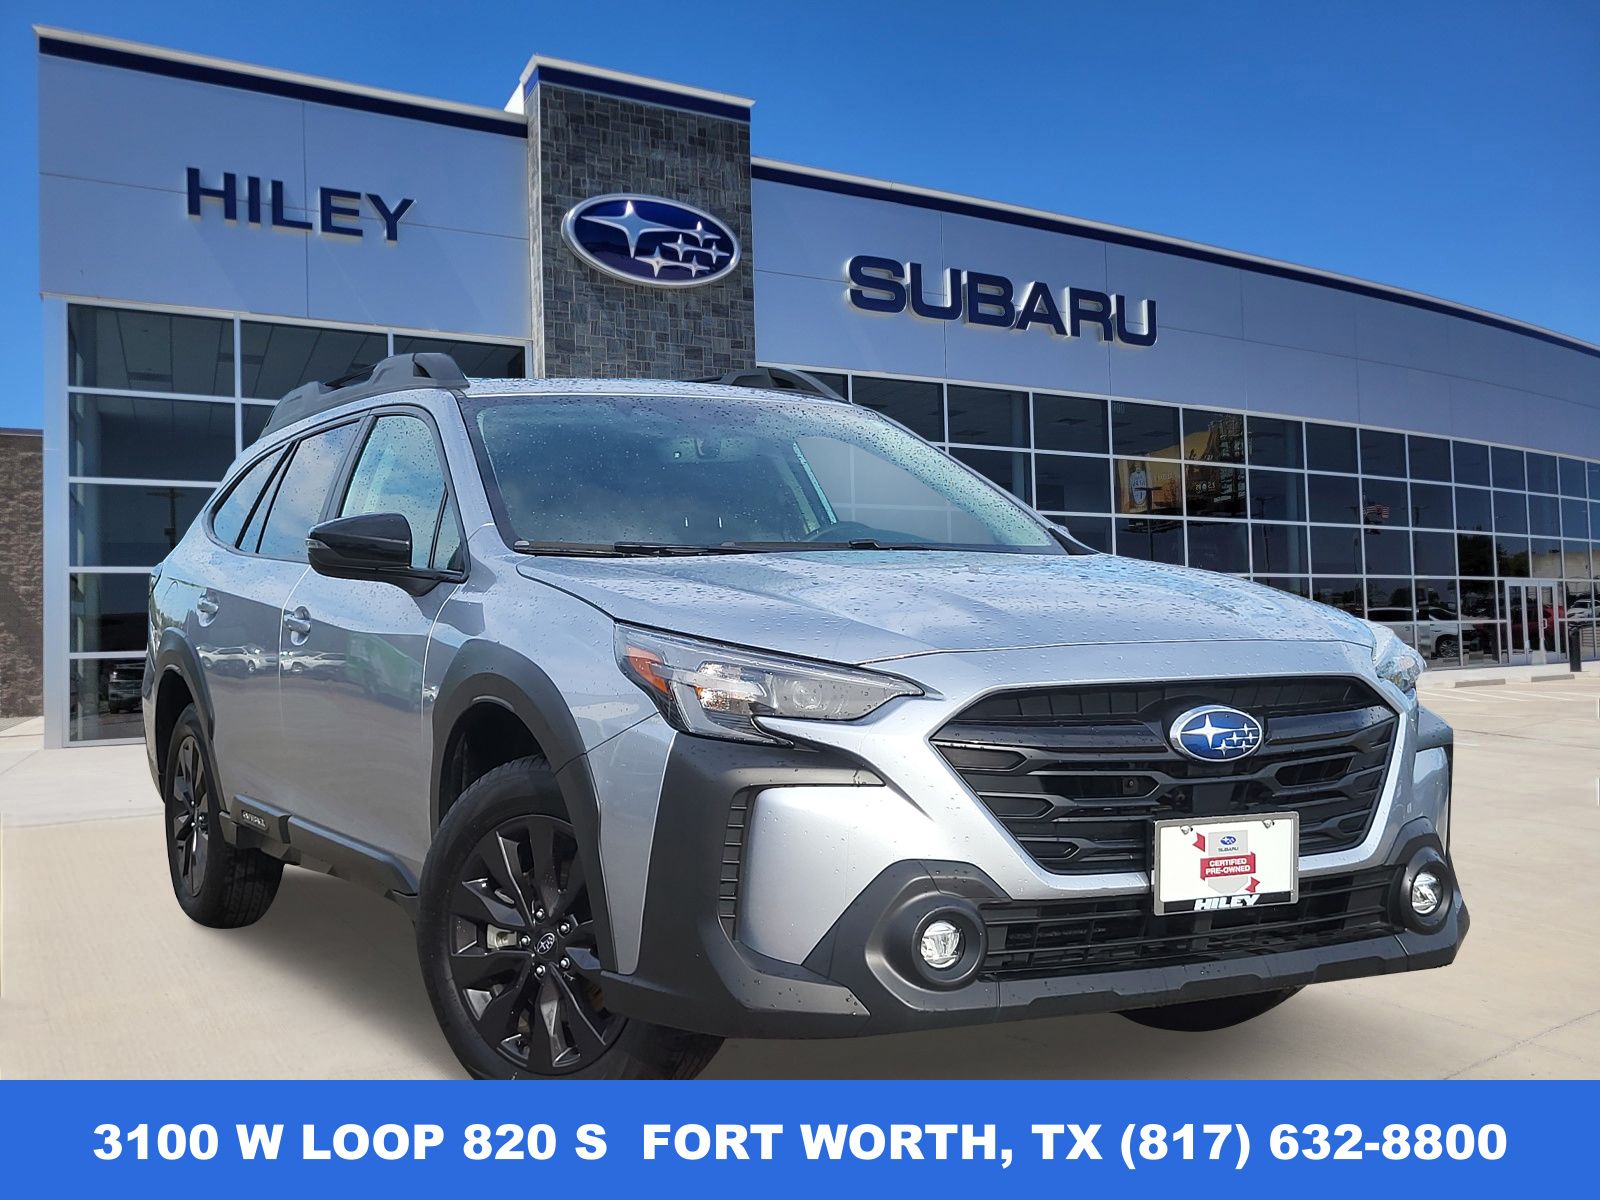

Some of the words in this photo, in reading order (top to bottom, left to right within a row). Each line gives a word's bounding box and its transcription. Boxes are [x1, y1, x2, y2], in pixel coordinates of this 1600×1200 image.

[187, 167, 415, 241] HILEY
[849, 255, 1157, 347] SUBARU
[1205, 865, 1251, 875] PRE-OWNED
[1209, 858, 1247, 866] CERTIFIED
[1193, 894, 1260, 911] HILEY
